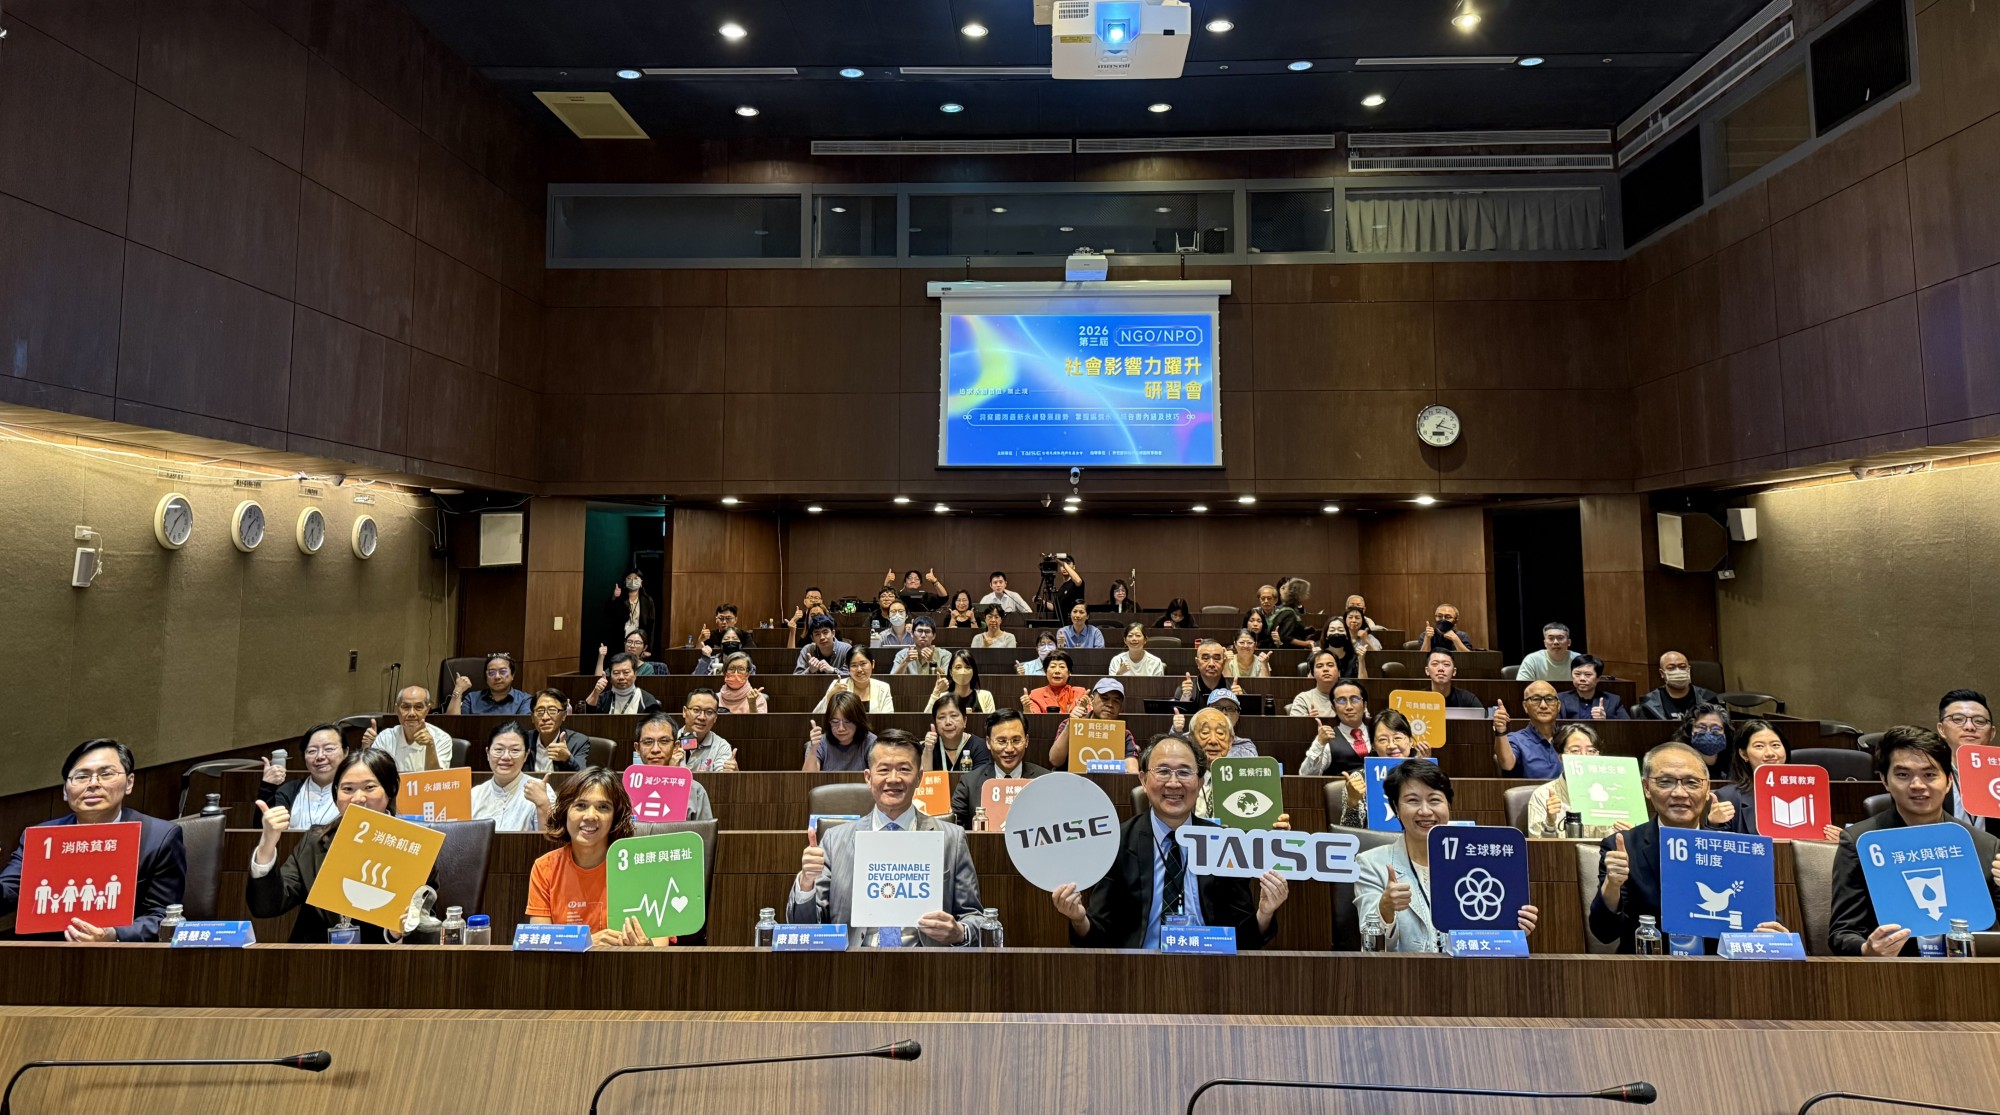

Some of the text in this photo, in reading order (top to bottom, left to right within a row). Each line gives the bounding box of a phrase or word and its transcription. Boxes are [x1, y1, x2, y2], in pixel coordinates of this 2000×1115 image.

[1079, 326, 1197, 343] 2026 NGO/NPO
[1079, 337, 1109, 347] 第三屆
[1065, 356, 1202, 376] 社會影響力躍升
[1144, 380, 1203, 400] 研習會
[1396, 696, 1402, 708] 7
[1073, 723, 1084, 736] 12
[1568, 760, 1584, 776] 15
[1970, 752, 2000, 768] 5 性
[629, 772, 687, 788] 10 減少不平等
[1219, 765, 1272, 781] 13 氣候行動
[1374, 765, 1388, 781] 14
[1765, 771, 1816, 787] 4 優質教育
[406, 780, 460, 796] 11 永續城市
[991, 786, 1001, 802] 8
[353, 821, 422, 856] 2 消除飢餓
[1013, 815, 1112, 849] TAISE
[44, 837, 117, 860] 1 消除貧窮
[1183, 833, 1353, 874] TAISE
[1441, 837, 1514, 860] 17 全球夥伴
[1666, 837, 1766, 861] 16 和平與正義
[1868, 843, 1964, 867] 6 淨水與衛生
[618, 847, 692, 871] 3 健康與福祉
[1695, 853, 1723, 868] 制度
[868, 863, 931, 872] SUSTAINABLE
[868, 872, 930, 881] DEVELOPMENT
[866, 882, 931, 899] GOALS
[1166, 935, 1200, 947] 申永順
